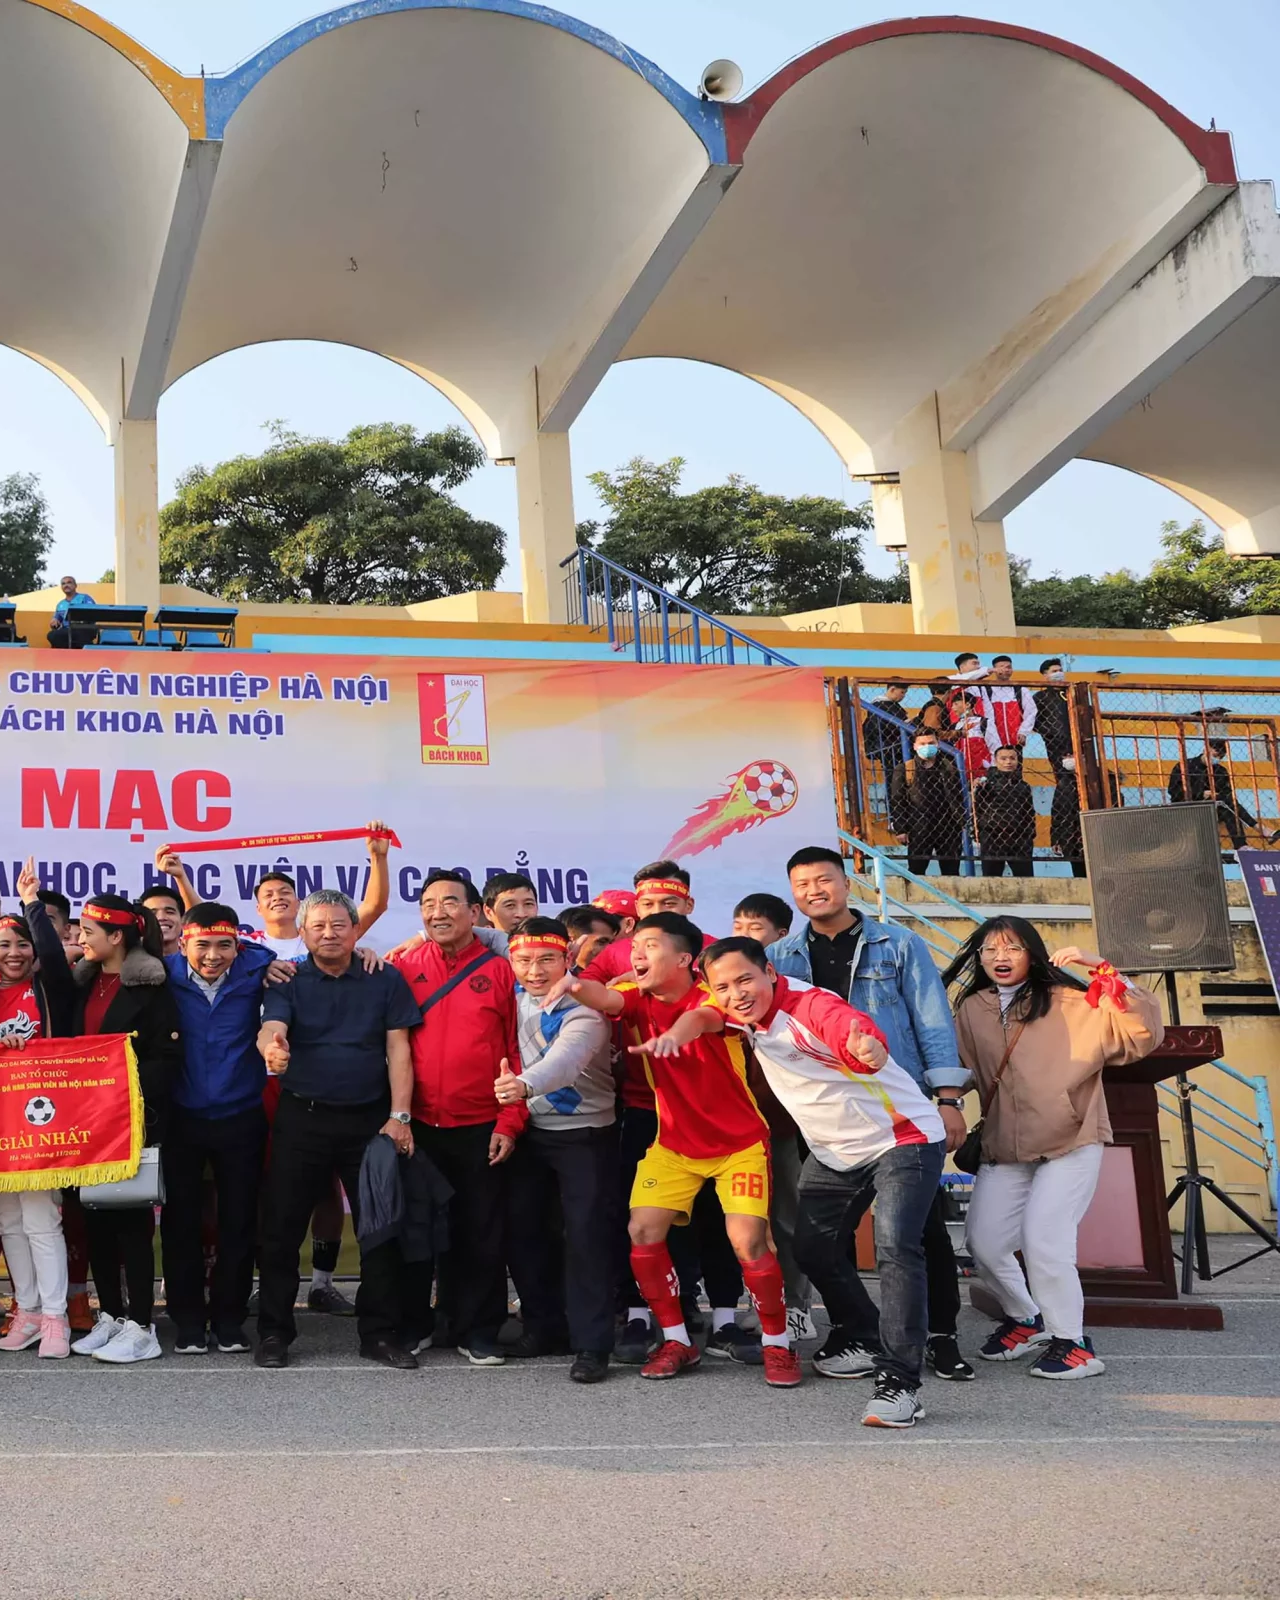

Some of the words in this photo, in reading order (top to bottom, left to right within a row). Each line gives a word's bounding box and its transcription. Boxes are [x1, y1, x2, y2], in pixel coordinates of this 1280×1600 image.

[9, 668, 139, 697] CHUYÊN
[150, 671, 270, 703] NGHIỆP
[280, 671, 324, 700] HÀ
[333, 674, 389, 705] NỘI
[76, 709, 164, 734] KHOA
[174, 708, 218, 735] HÀ
[228, 709, 284, 740] NỘI
[429, 748, 455, 761] BÁCH
[456, 751, 483, 762] KHOA
[21, 767, 233, 843] MẠC
[10, 1071, 28, 1081] BAN
[29, 1068, 42, 1078] TỔ
[43, 1069, 69, 1078] CHỨC
[26, 1081, 41, 1090] SINH
[42, 1080, 57, 1089] VIÊN
[99, 1077, 116, 1086] 2020
[38, 1126, 91, 1146] NHẤT
